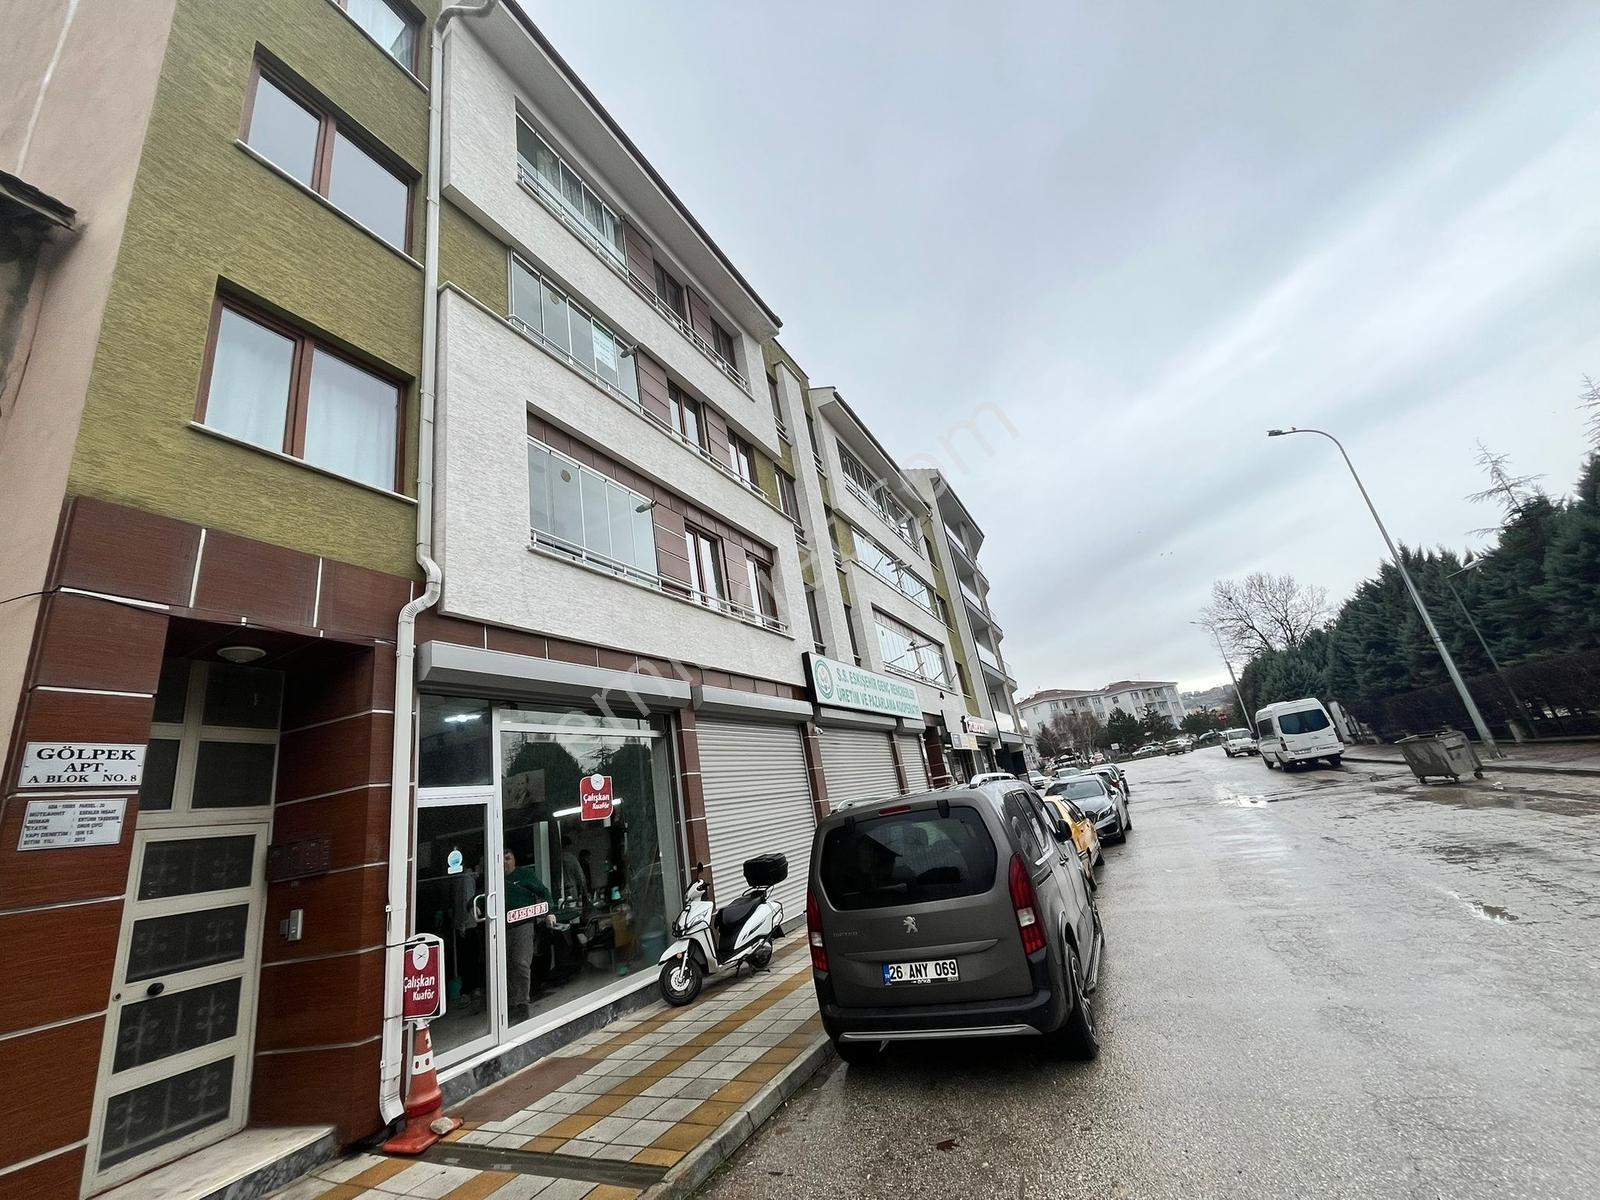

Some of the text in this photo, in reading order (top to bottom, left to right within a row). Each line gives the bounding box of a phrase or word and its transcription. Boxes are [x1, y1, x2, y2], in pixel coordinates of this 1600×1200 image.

[860, 692, 869, 706] VE
[37, 745, 136, 760] GÖLPEK
[63, 763, 108, 773] APT.
[27, 774, 137, 784] A BLOK NO. 8
[583, 793, 610, 803] Çalışkan
[889, 961, 957, 980] 26 ANY 069
[404, 973, 435, 993] Çalışkan
[412, 989, 435, 1001] Kuaför
